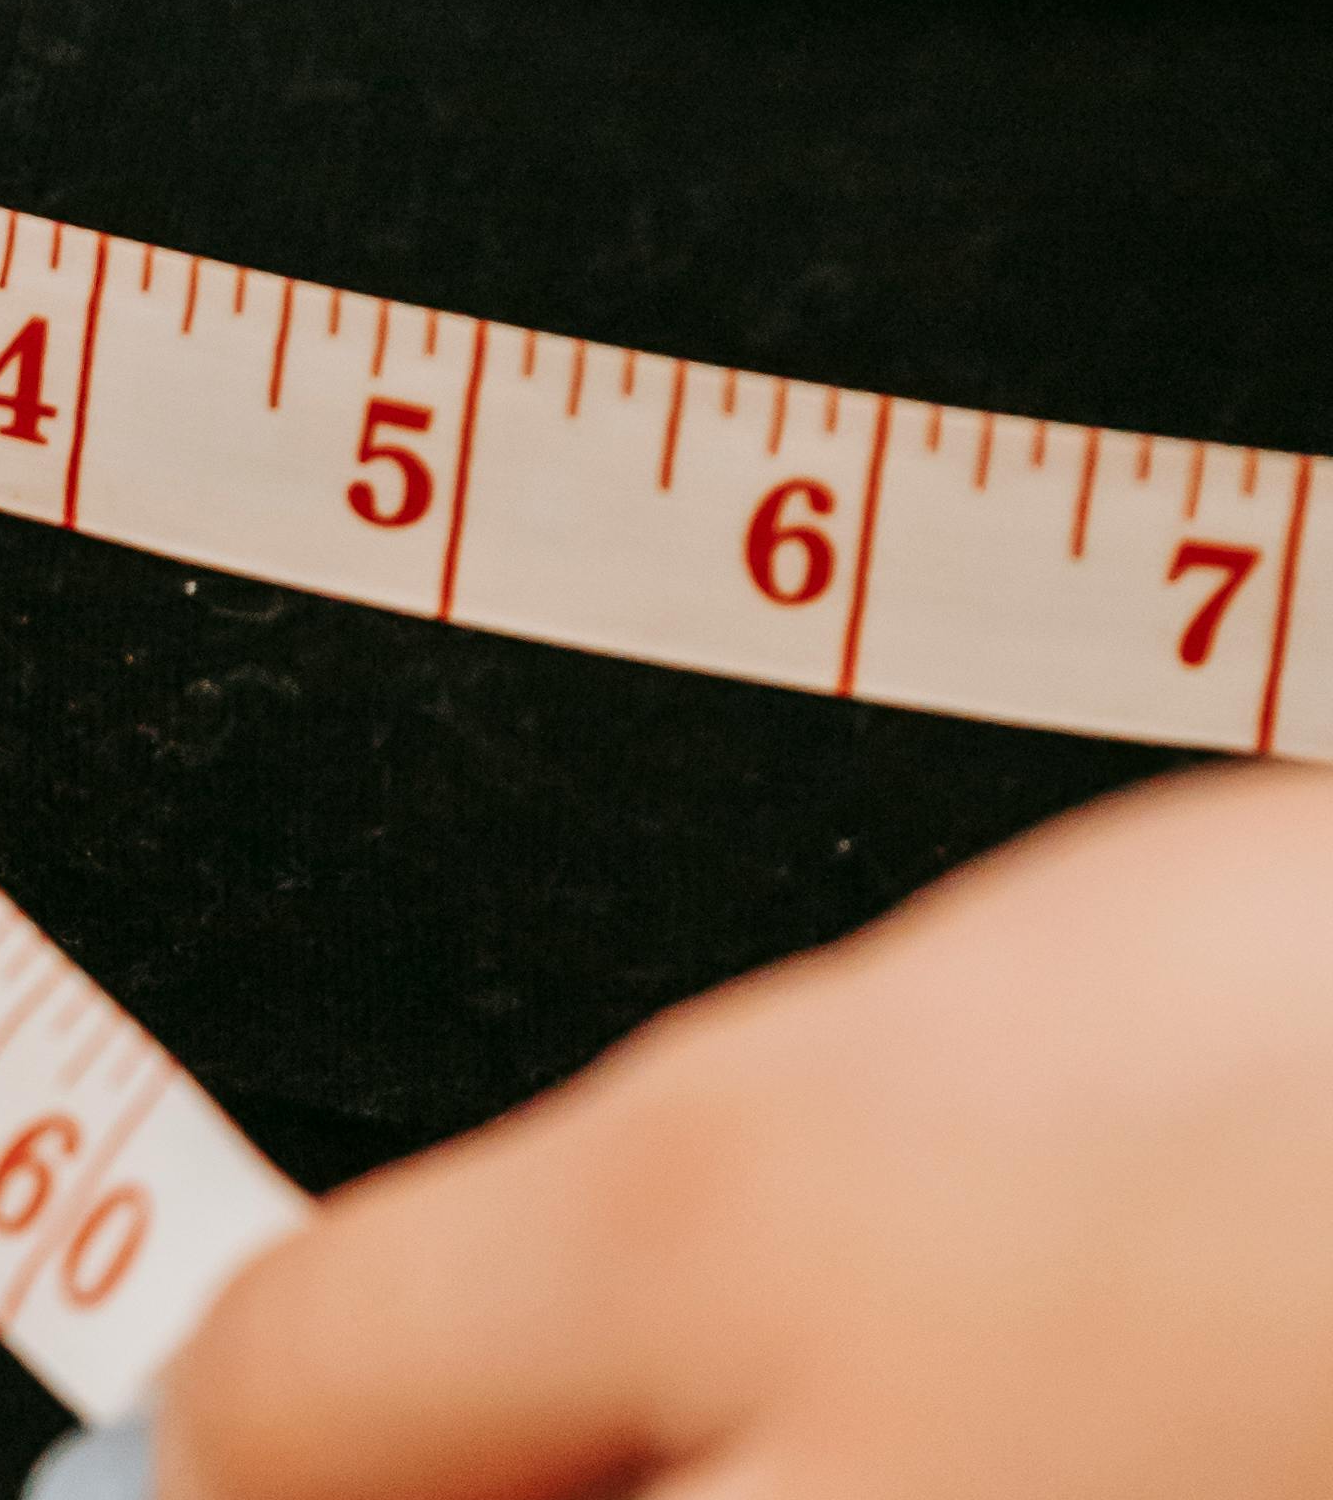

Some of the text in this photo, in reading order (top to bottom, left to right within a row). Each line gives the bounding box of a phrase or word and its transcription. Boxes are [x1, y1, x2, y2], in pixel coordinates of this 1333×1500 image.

[345, 395, 434, 530] 5
[742, 476, 837, 608] 6
[1165, 537, 1264, 669] 7
